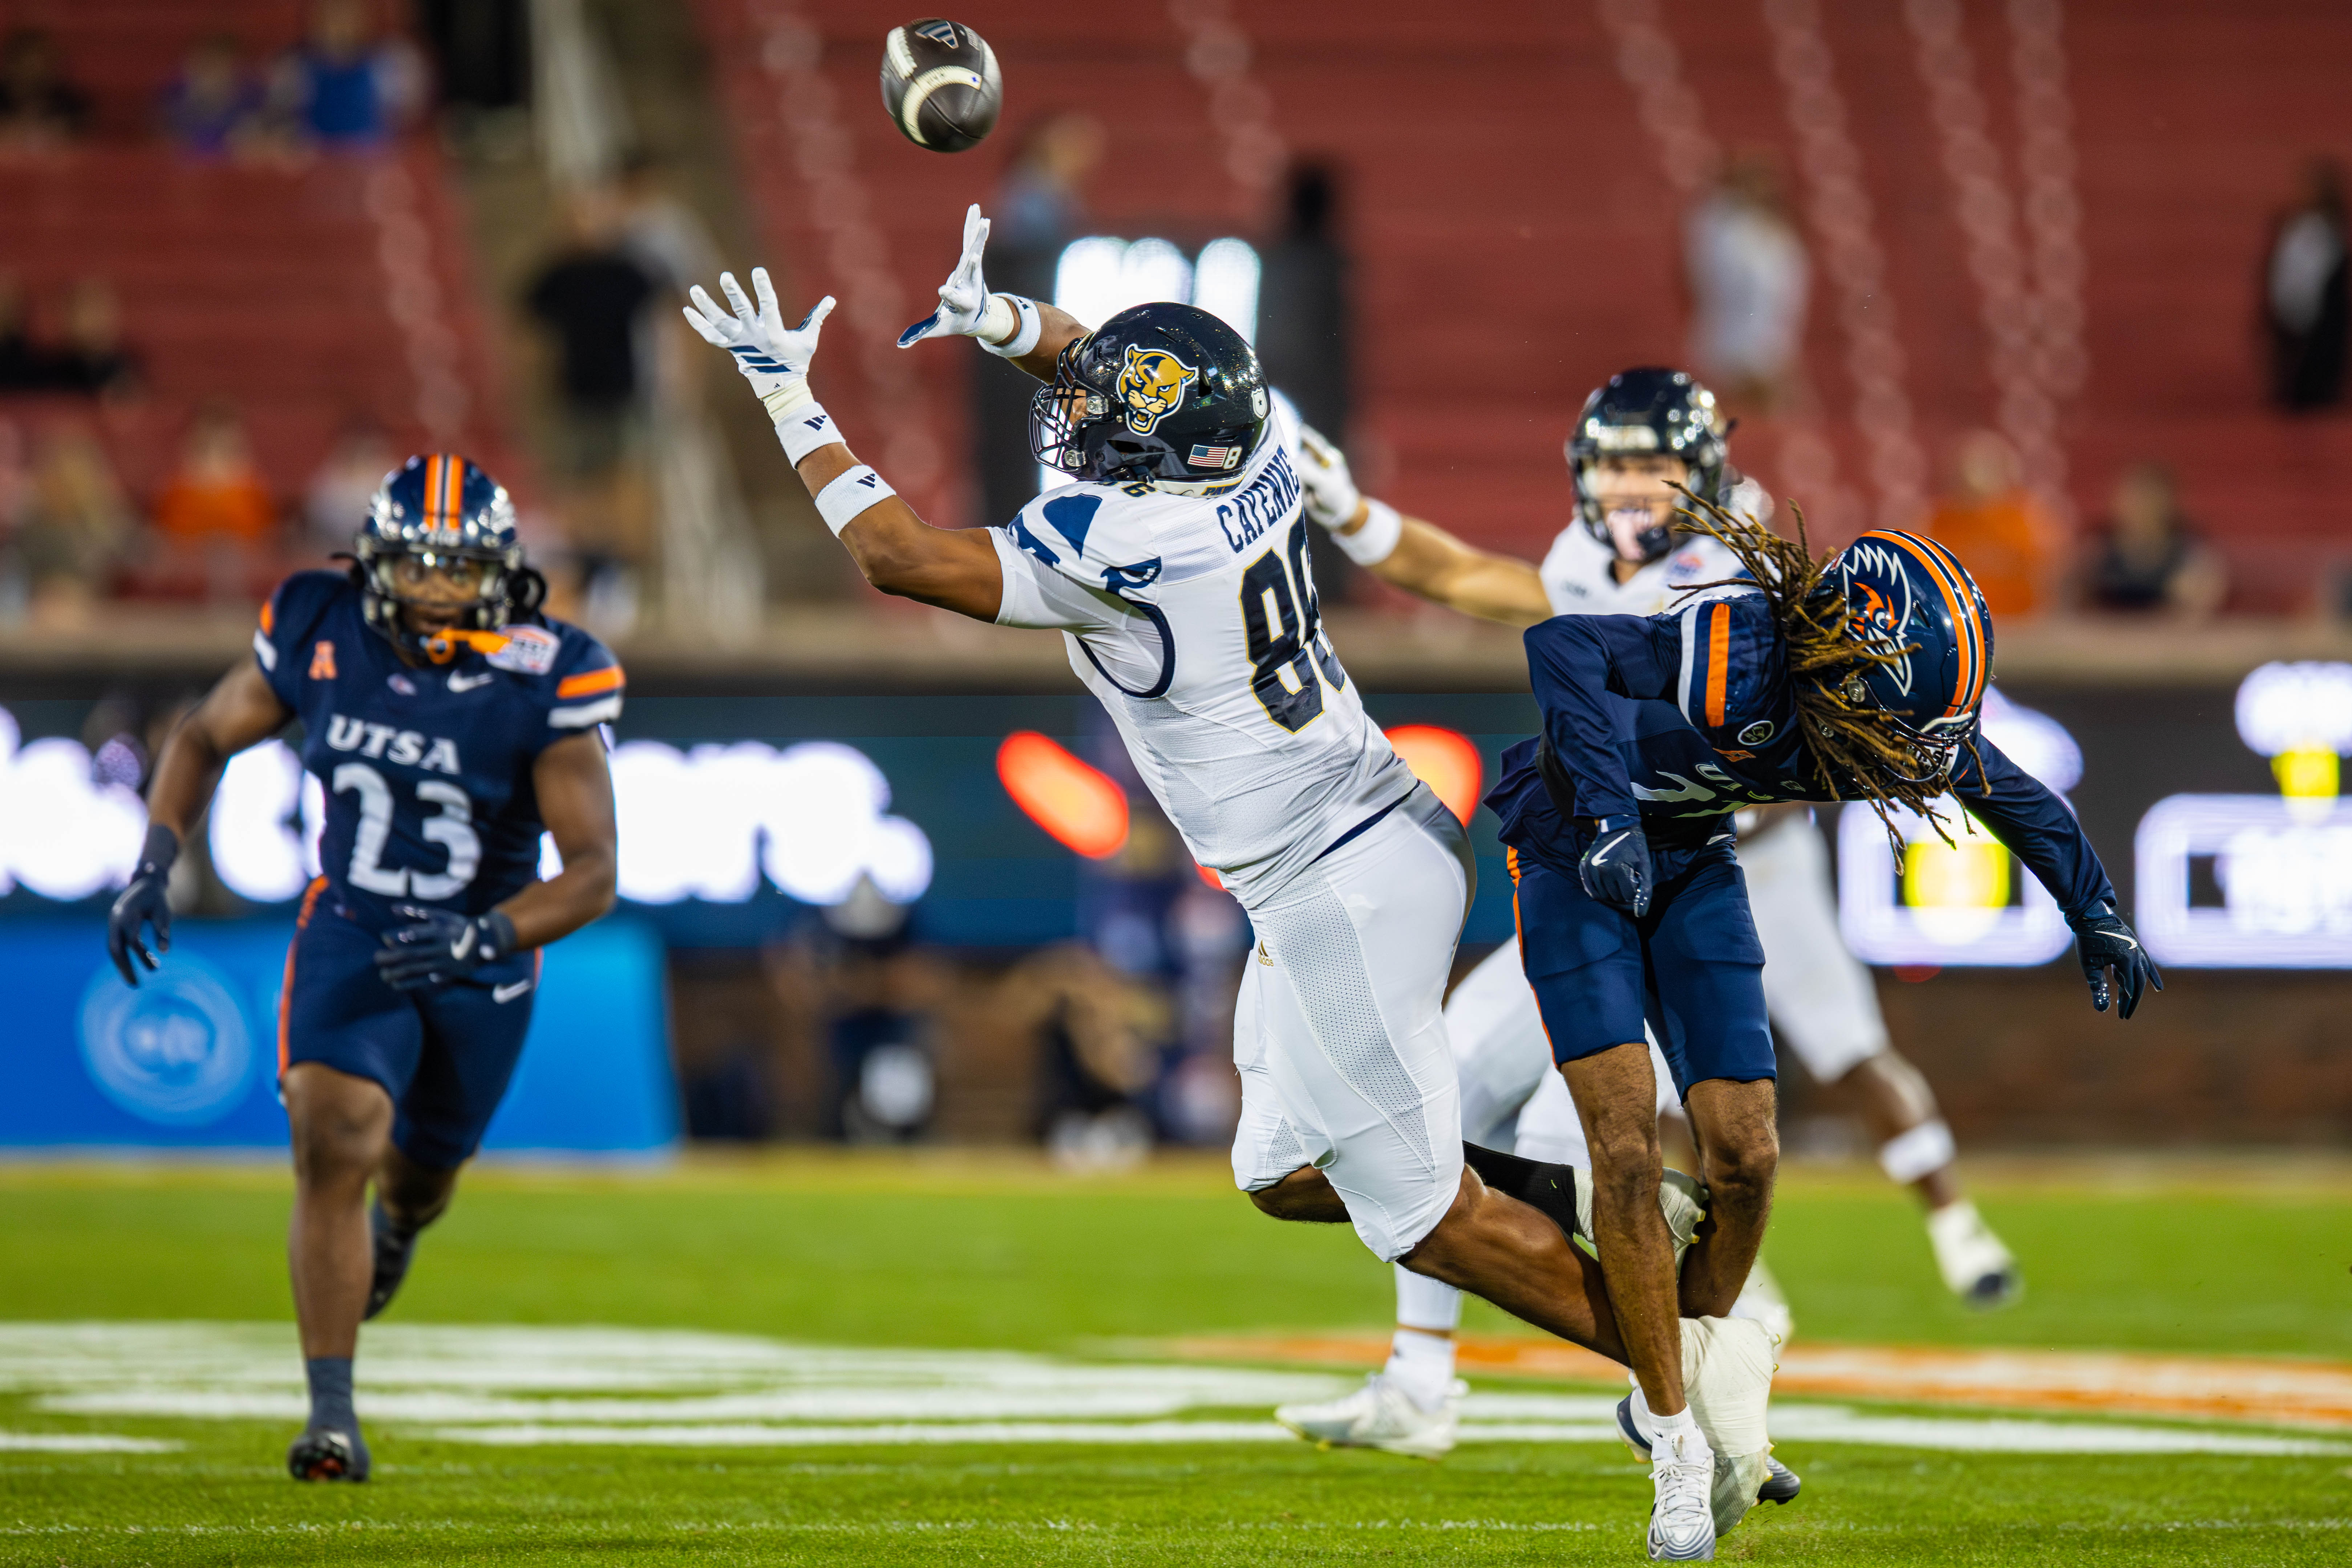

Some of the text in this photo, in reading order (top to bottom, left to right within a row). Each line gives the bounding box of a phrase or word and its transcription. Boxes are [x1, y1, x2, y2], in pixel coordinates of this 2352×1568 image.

[1223, 445, 1243, 470] 8
[1217, 444, 1300, 554] CAYENNE
[325, 713, 461, 775] UTSA
[332, 762, 482, 900] 23
[1258, 954, 1274, 967] didas
